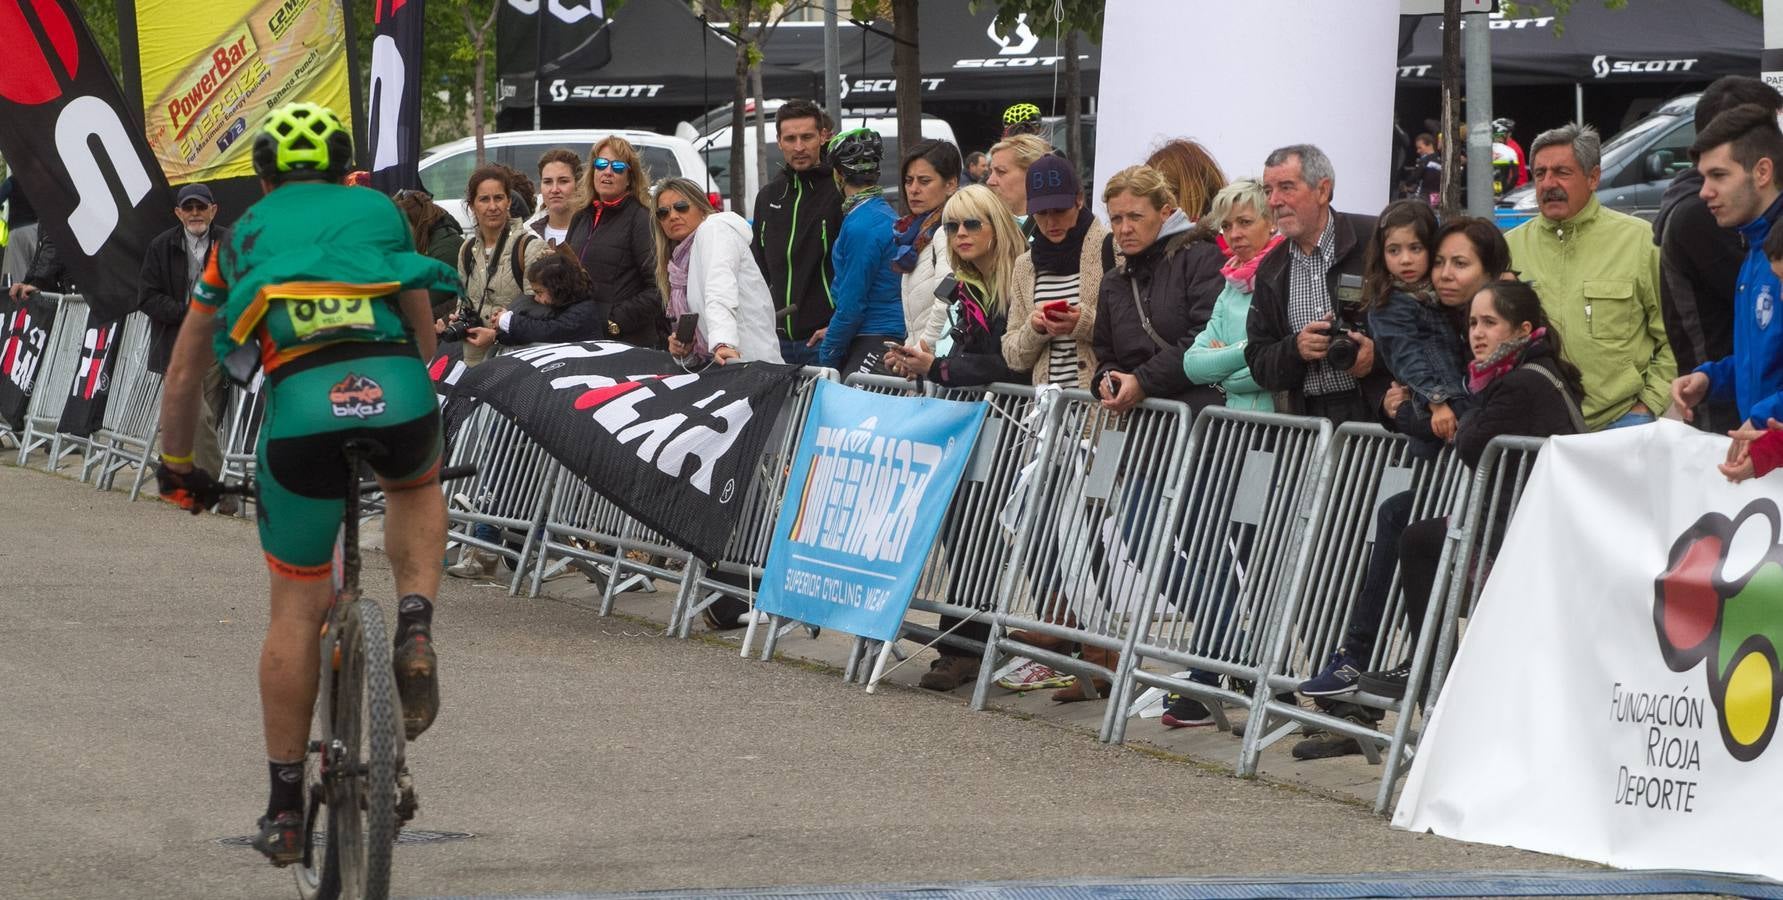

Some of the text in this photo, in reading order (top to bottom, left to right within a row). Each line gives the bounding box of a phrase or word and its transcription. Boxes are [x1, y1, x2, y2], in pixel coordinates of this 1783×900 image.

[167, 35, 246, 130] PowerBar
[266, 79, 295, 109] Banana
[294, 50, 317, 79] Punch
[952, 56, 1089, 69] SCOT
[1611, 59, 1698, 72] SCOTT
[180, 57, 268, 159] ENERGIZE
[196, 119, 226, 153] Maximum
[224, 98, 247, 122] Energy
[245, 70, 271, 98] Delivery
[570, 85, 664, 98] SCOTT
[784, 568, 891, 612] SUPERIOR CYCLING WEAR
[1609, 683, 1704, 729] FUNDACIÓN
[1646, 726, 1700, 772] RIOJA
[1615, 765, 1697, 812] DEPORTE
